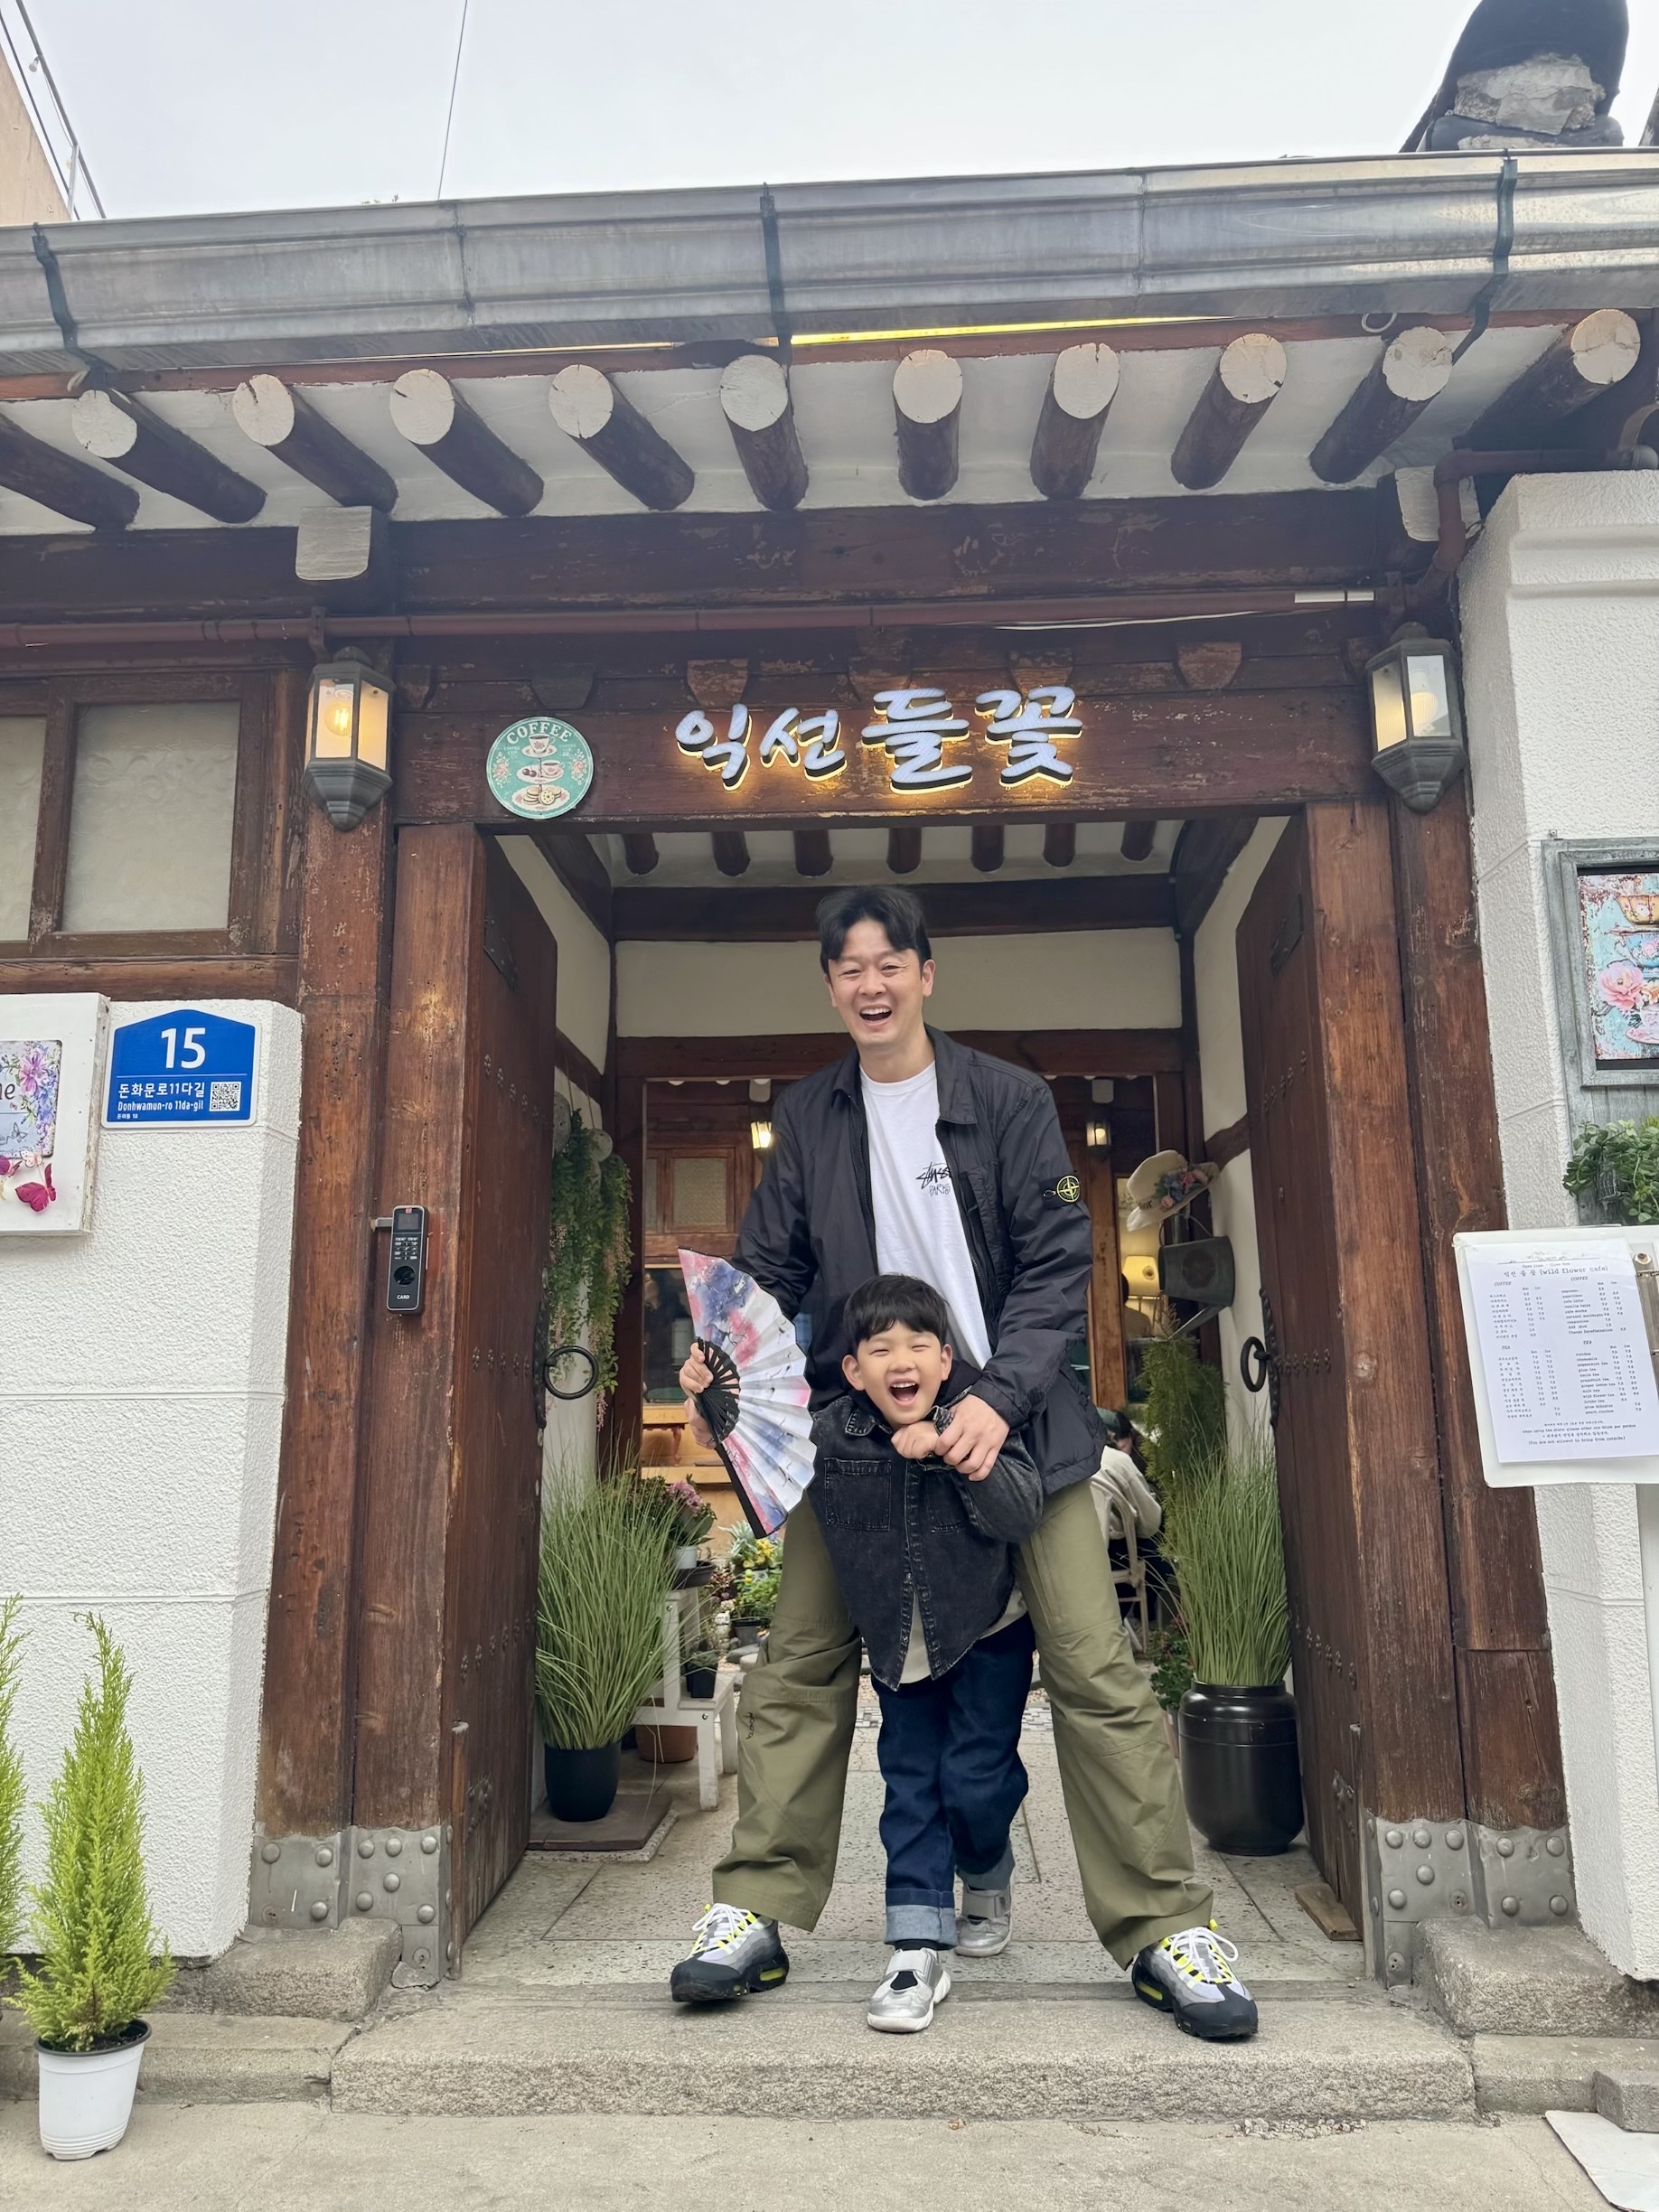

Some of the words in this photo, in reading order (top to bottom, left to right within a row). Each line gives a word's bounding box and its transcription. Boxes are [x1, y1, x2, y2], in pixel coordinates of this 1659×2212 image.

[506, 722, 572, 745] COFFEE
[675, 704, 847, 791] 익선
[861, 687, 1083, 794] 들꽃
[161, 1027, 206, 1069] 15
[118, 1082, 205, 1099] 돈화문로11다길
[117, 1101, 173, 1111] Donhwamun-ro
[174, 1100, 204, 1112] 11da-gil
